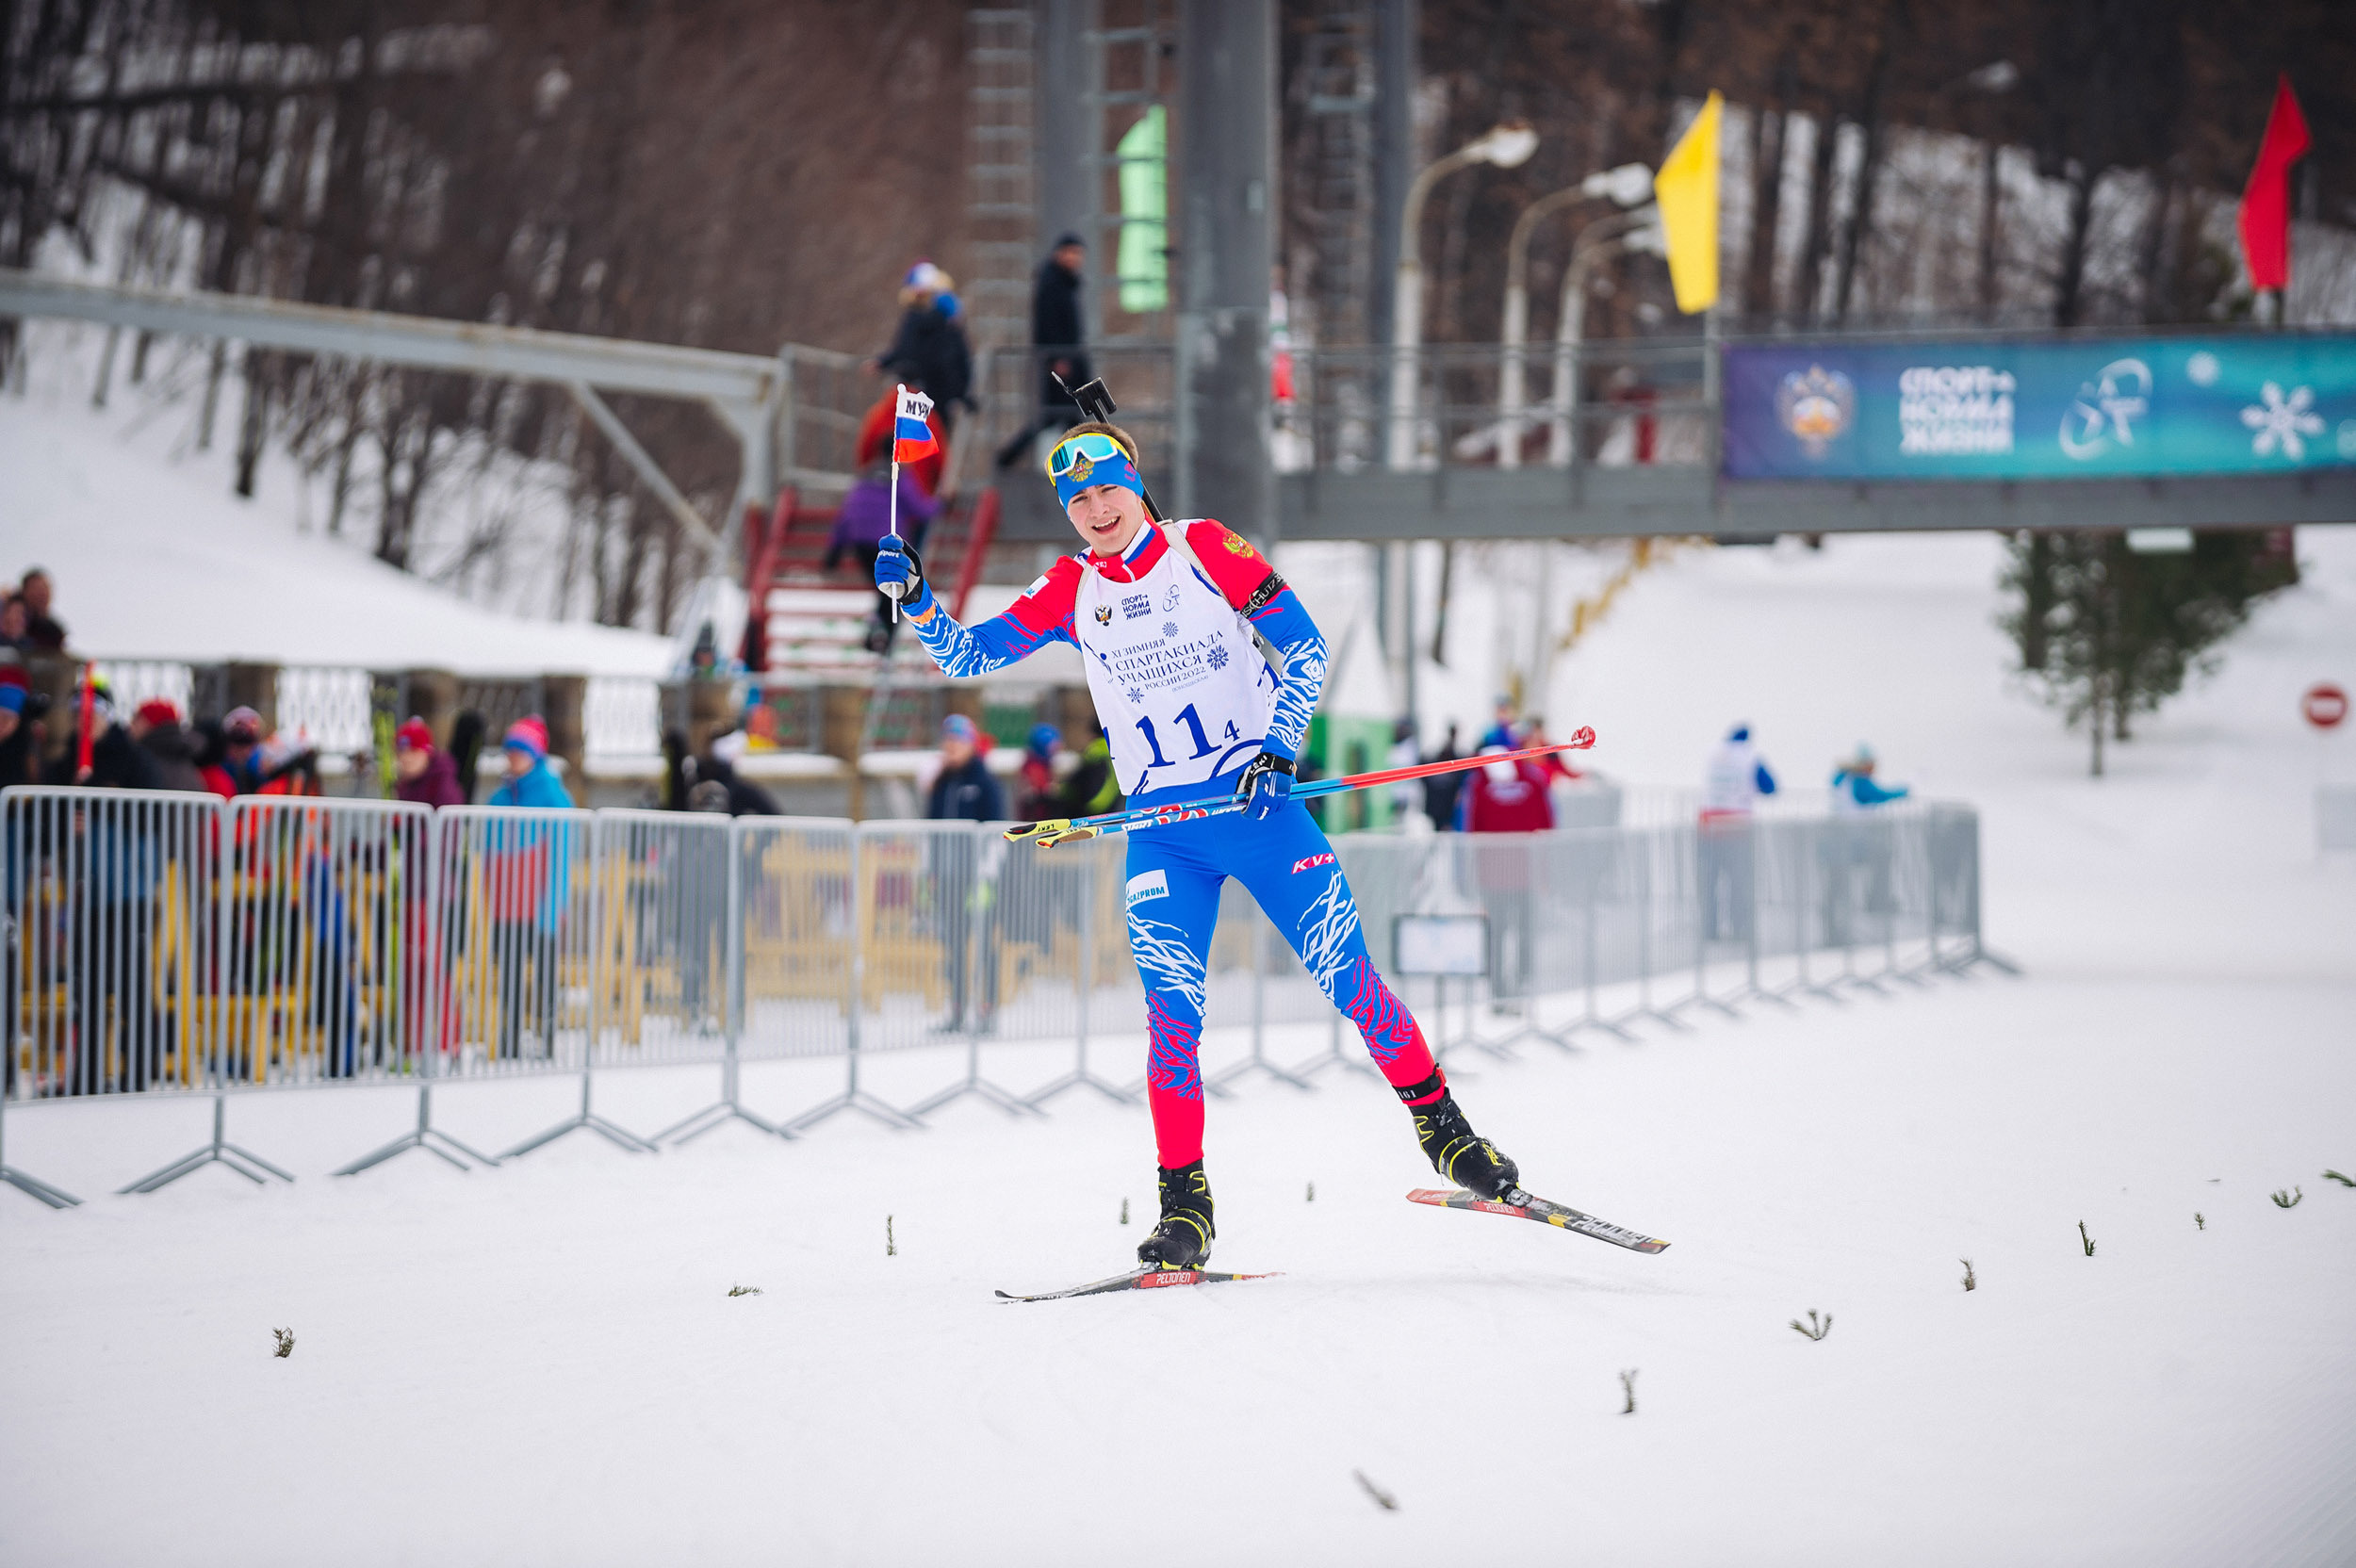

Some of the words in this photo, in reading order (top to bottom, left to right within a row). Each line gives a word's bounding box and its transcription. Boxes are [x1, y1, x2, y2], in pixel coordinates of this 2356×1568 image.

[1121, 594, 1142, 606] СПОРТ
[1122, 600, 1151, 612] НОРМА
[1125, 608, 1152, 620] ЖИЗНИ
[1115, 629, 1223, 672] СПАРТАКИАДА
[1122, 638, 1166, 656] ЗИМНЯЯ
[1117, 654, 1203, 686] УЧАЩИХСЯ
[1144, 674, 1182, 690] РОССИИ
[1181, 665, 1206, 680] 2022
[1135, 702, 1223, 769] 11
[1223, 719, 1241, 743] 4
[1038, 823, 1055, 832] LEKI
[1155, 1272, 1191, 1284] PELTONEN
